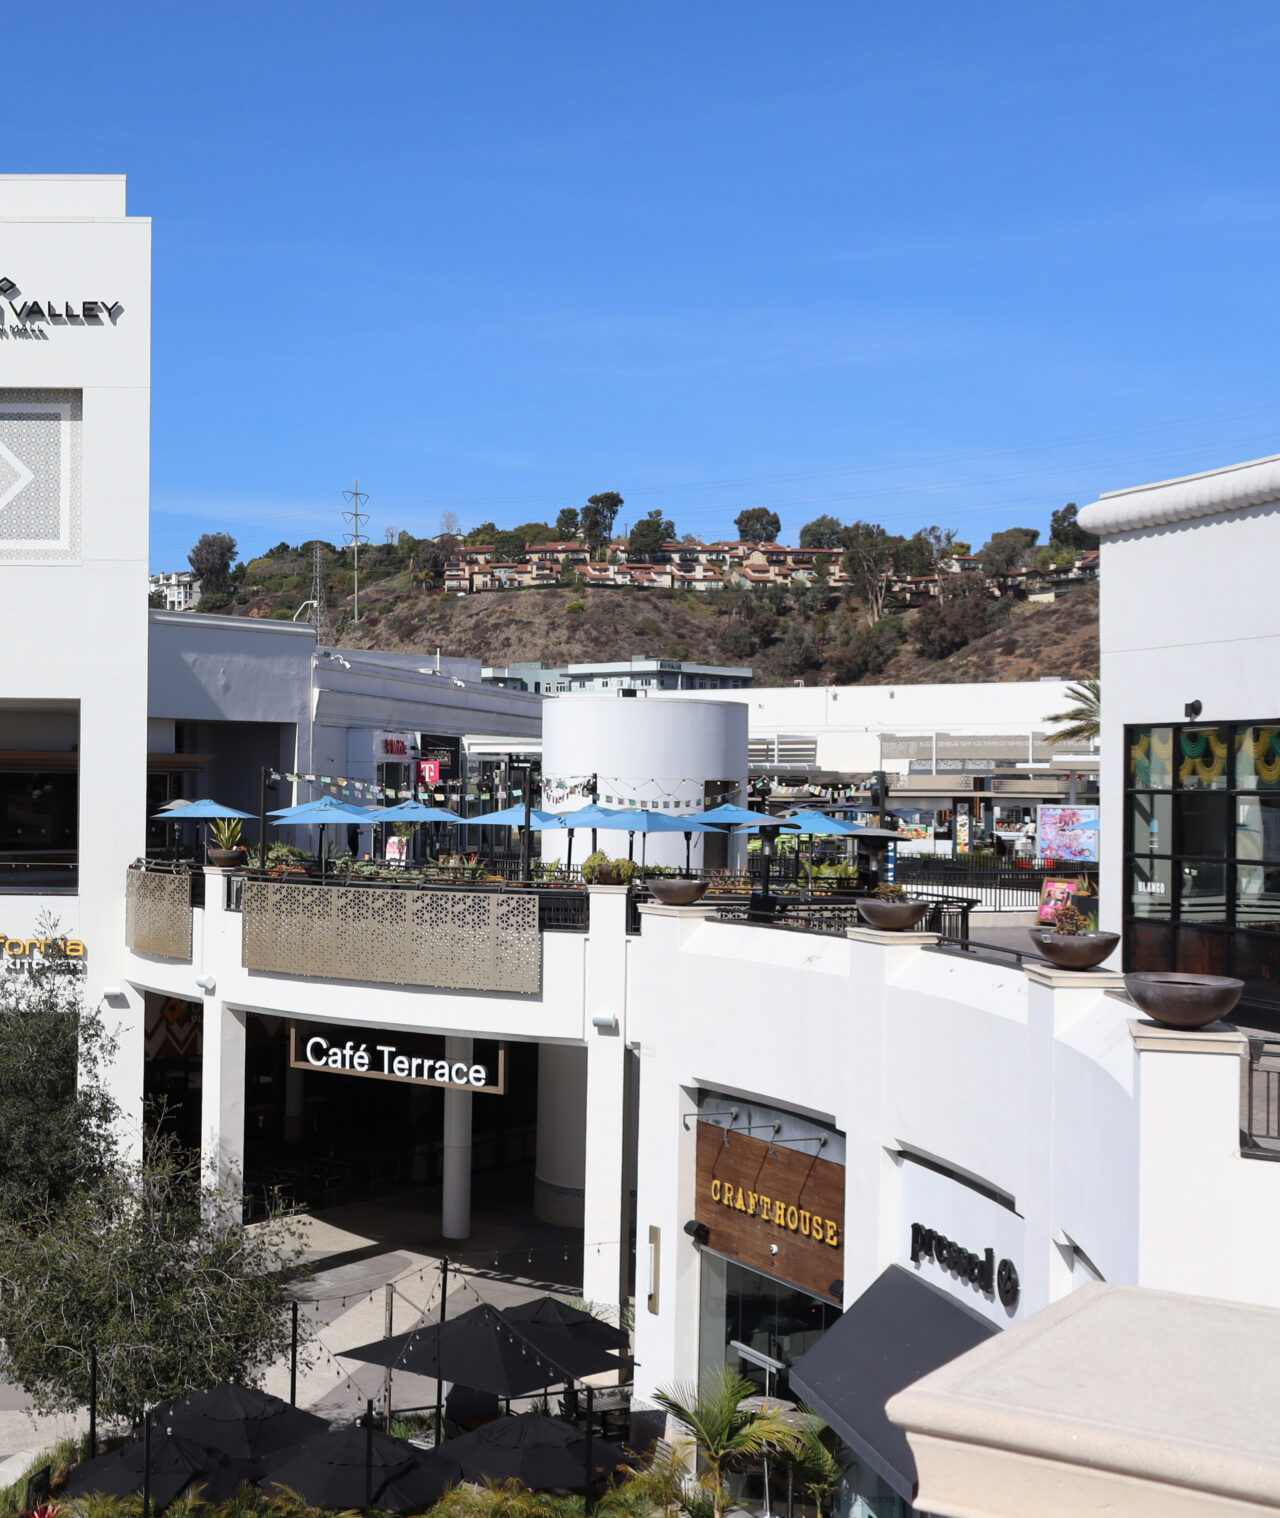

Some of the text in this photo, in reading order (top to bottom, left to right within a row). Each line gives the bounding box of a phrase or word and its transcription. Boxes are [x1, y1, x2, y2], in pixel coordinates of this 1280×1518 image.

[9, 300, 120, 318] VALLEY
[9, 323, 45, 334] MALL
[420, 763, 435, 783] T
[1137, 881, 1166, 894] BLANCO
[306, 1036, 488, 1088] Café Terrace
[711, 1179, 839, 1247] CRAFTHOUSE
[910, 1222, 995, 1295] pressed
